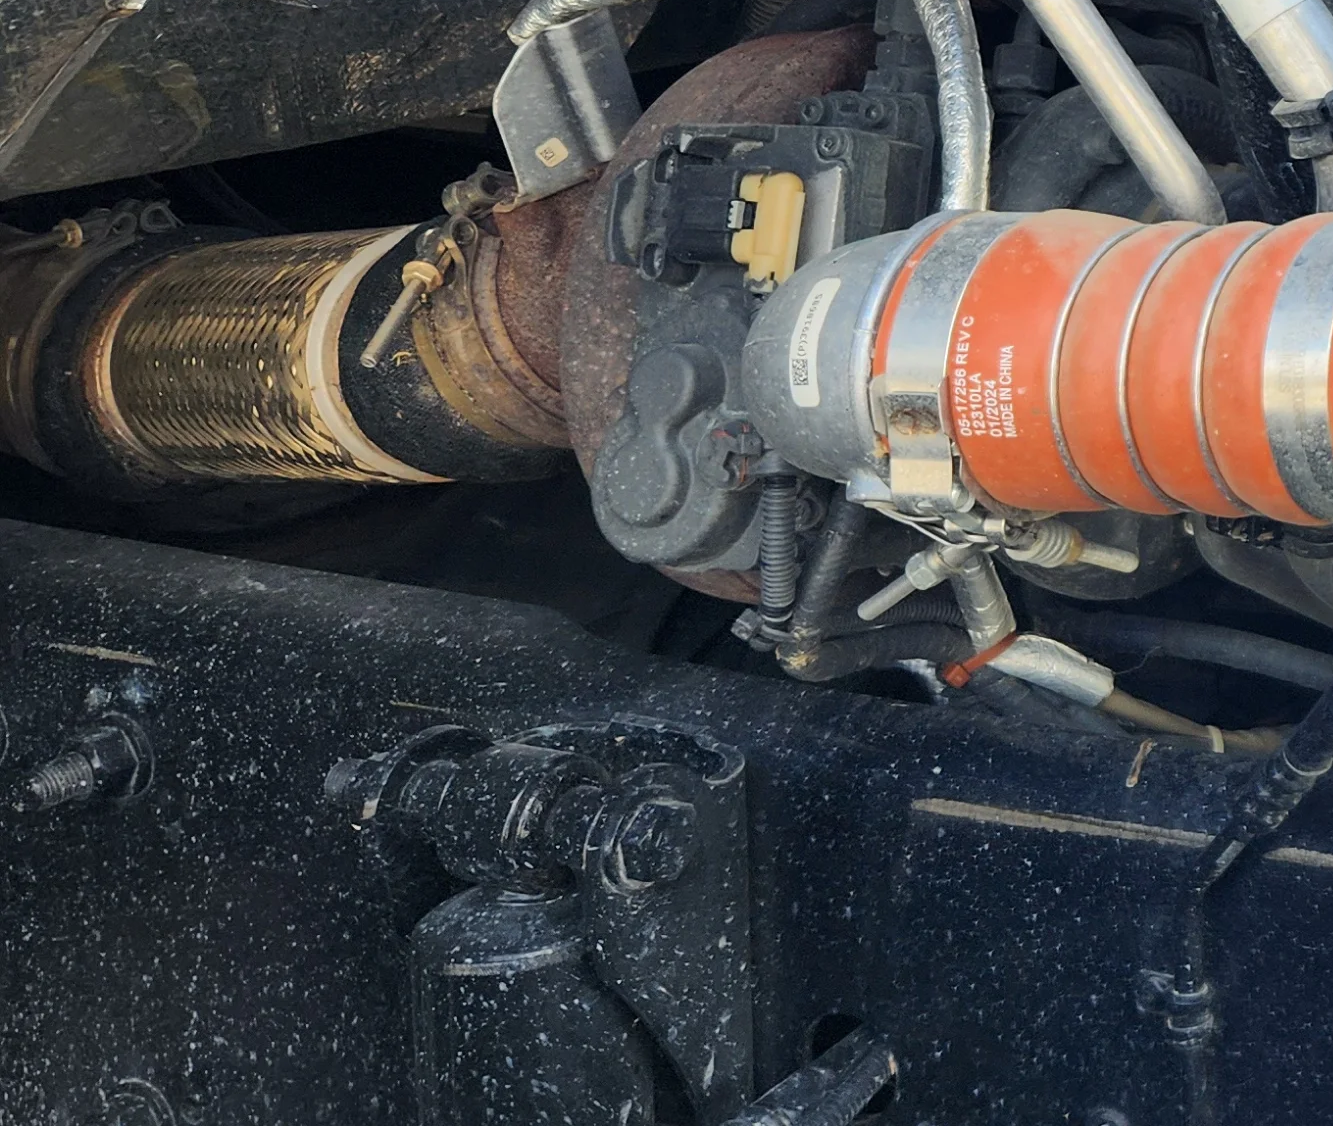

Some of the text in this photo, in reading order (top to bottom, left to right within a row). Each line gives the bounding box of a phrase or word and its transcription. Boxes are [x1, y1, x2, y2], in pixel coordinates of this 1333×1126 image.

[953, 315, 975, 437] 05-17256 REV C
[1000, 345, 1014, 385] CHINA
[969, 372, 986, 437] 12310LA
[984, 379, 1003, 438] 01/2024
[1002, 403, 1017, 439] MADE
